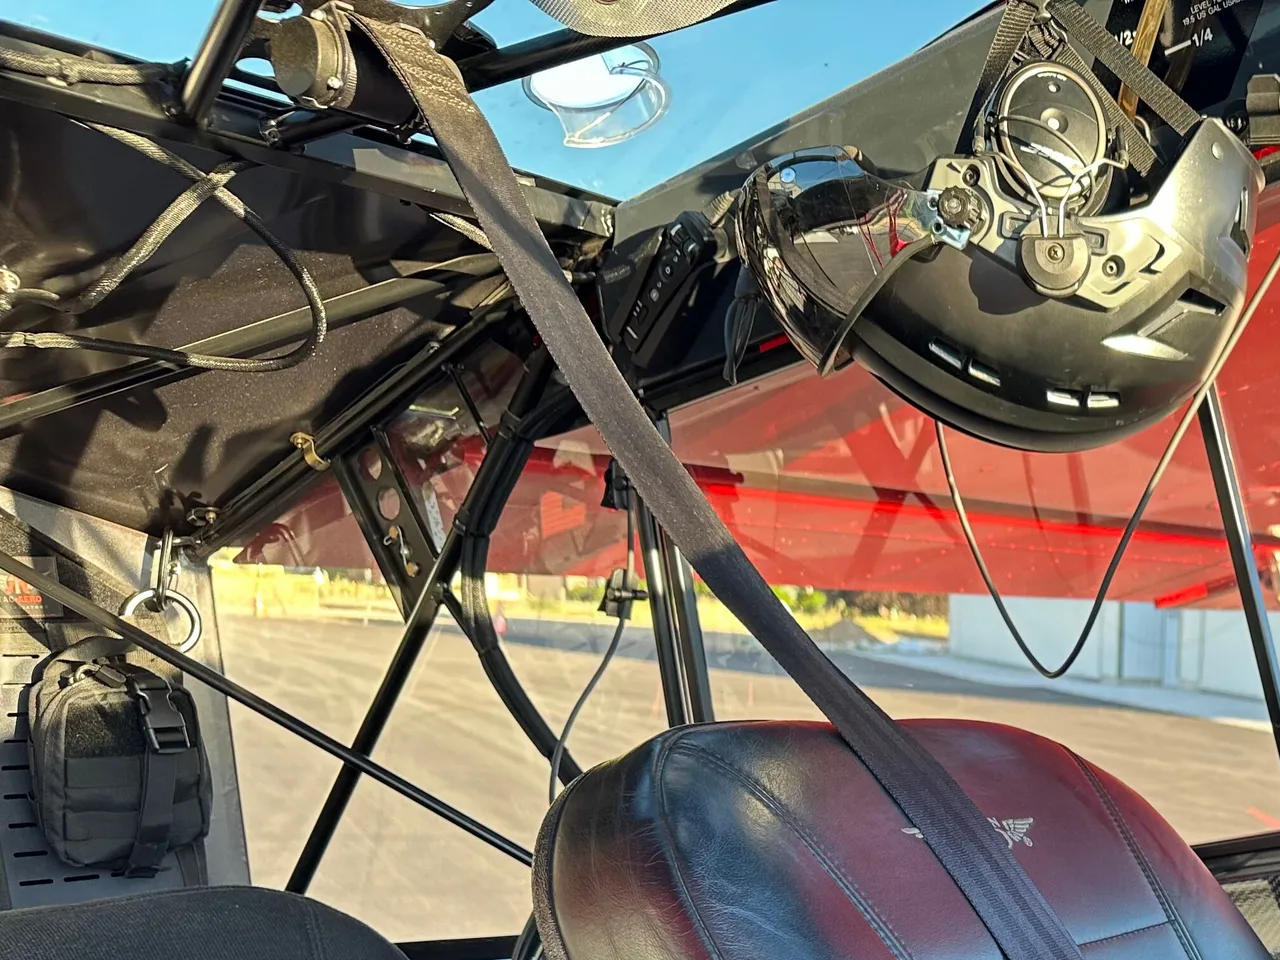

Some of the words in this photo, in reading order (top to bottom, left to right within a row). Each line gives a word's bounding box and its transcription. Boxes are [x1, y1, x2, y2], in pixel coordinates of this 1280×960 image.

[1190, 1, 1211, 14] LEVEL
[1197, 11, 1206, 20] US
[1208, 4, 1221, 15] GAL
[1192, 28, 1213, 47] 1/4
